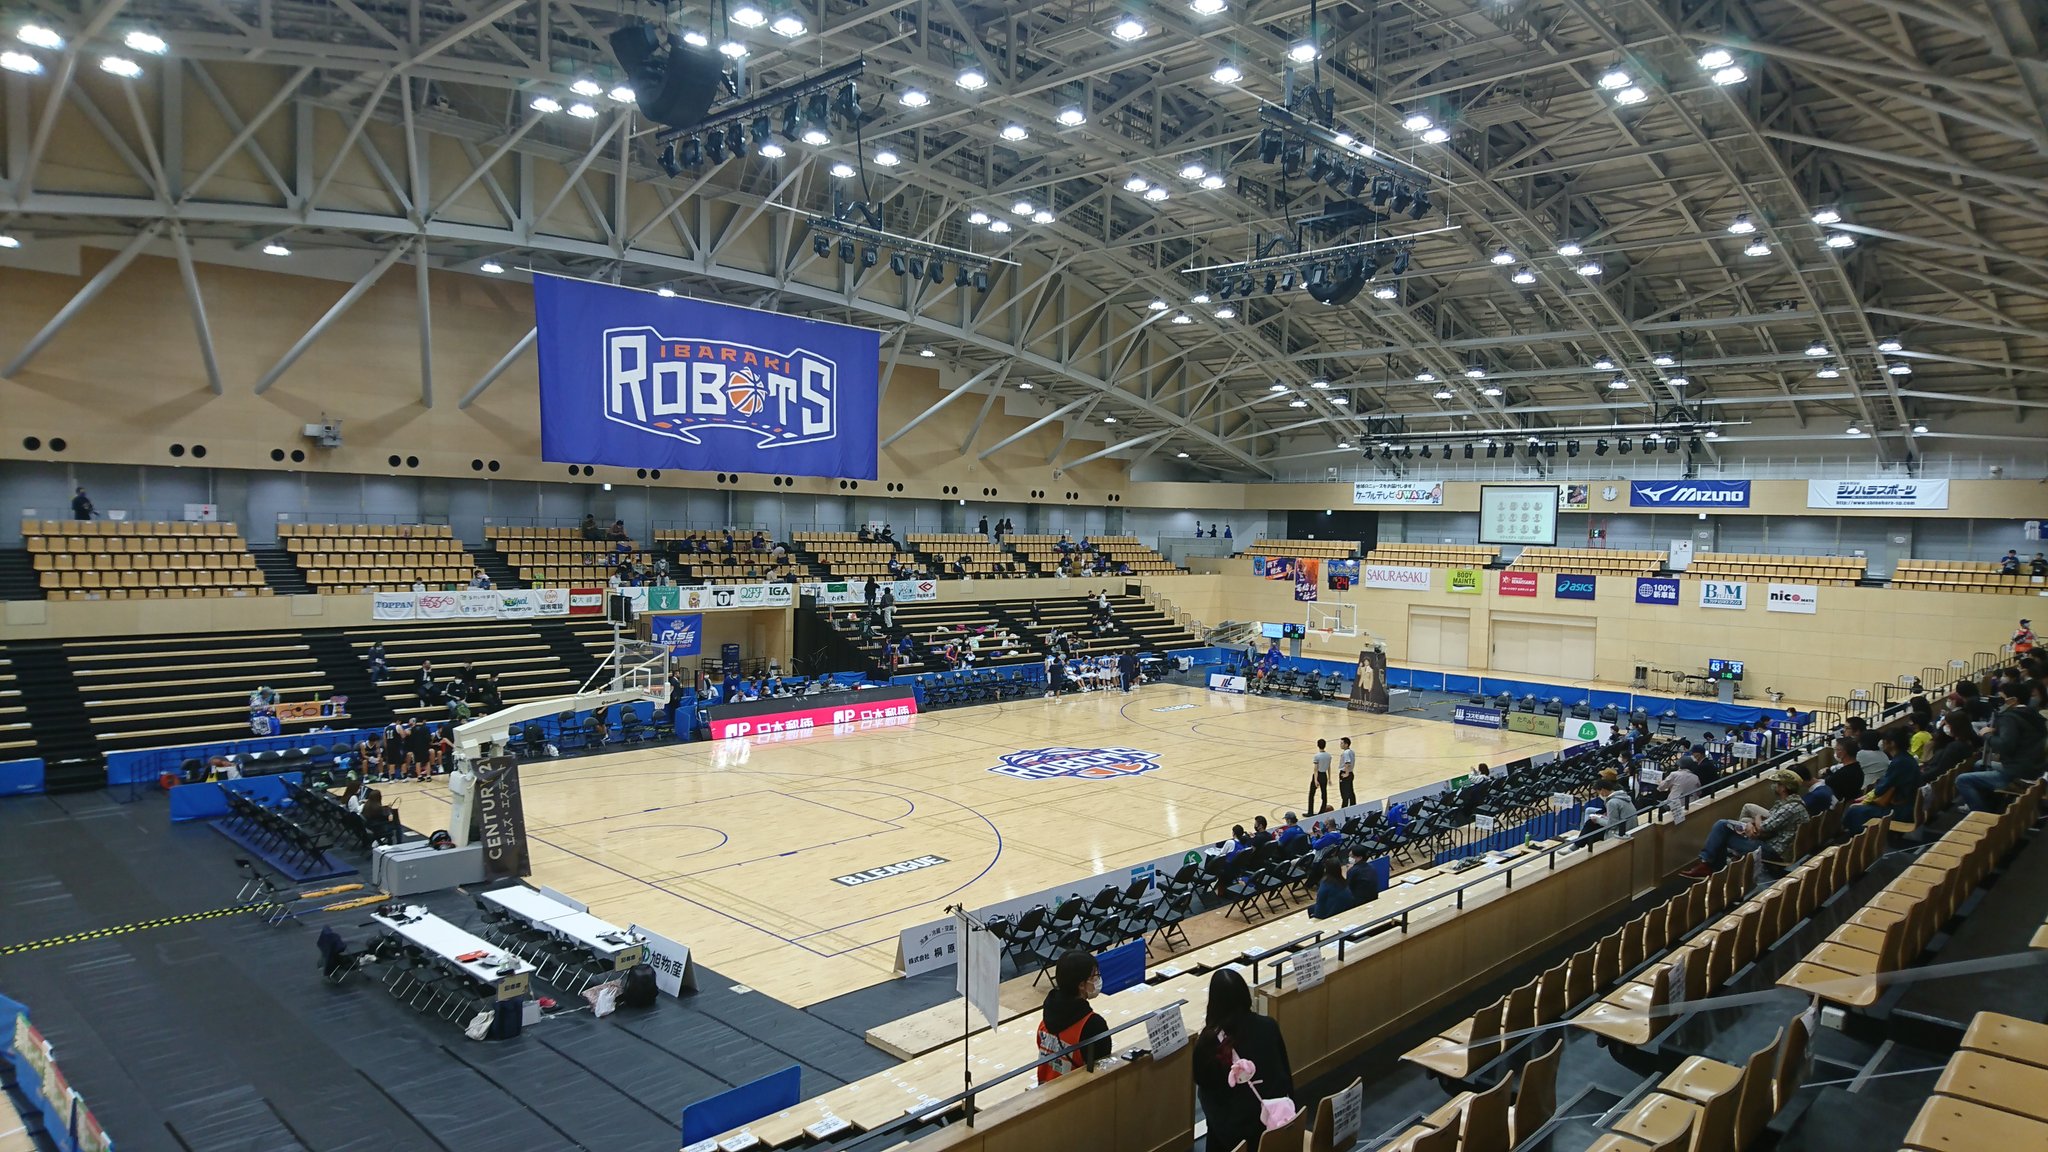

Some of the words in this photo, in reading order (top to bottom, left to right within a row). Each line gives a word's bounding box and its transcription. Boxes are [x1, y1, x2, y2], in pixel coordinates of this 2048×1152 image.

[660, 343, 791, 374] IBARAKI
[1670, 487, 1744, 502] MIZUNO
[1837, 484, 1917, 495] シノハラスポーツ
[1336, 577, 1348, 589] 24
[1569, 582, 1594, 592] asics
[1653, 584, 1676, 592] 100%
[768, 586, 790, 596] IGA
[376, 601, 414, 609] TOPPAN
[661, 630, 696, 641] RISE
[1710, 662, 1720, 672] 43
[1731, 664, 1742, 674] 33
[480, 777, 503, 860] CENTURY
[837, 855, 945, 885] B.LEAGUE
[650, 950, 683, 978] 旭物産
